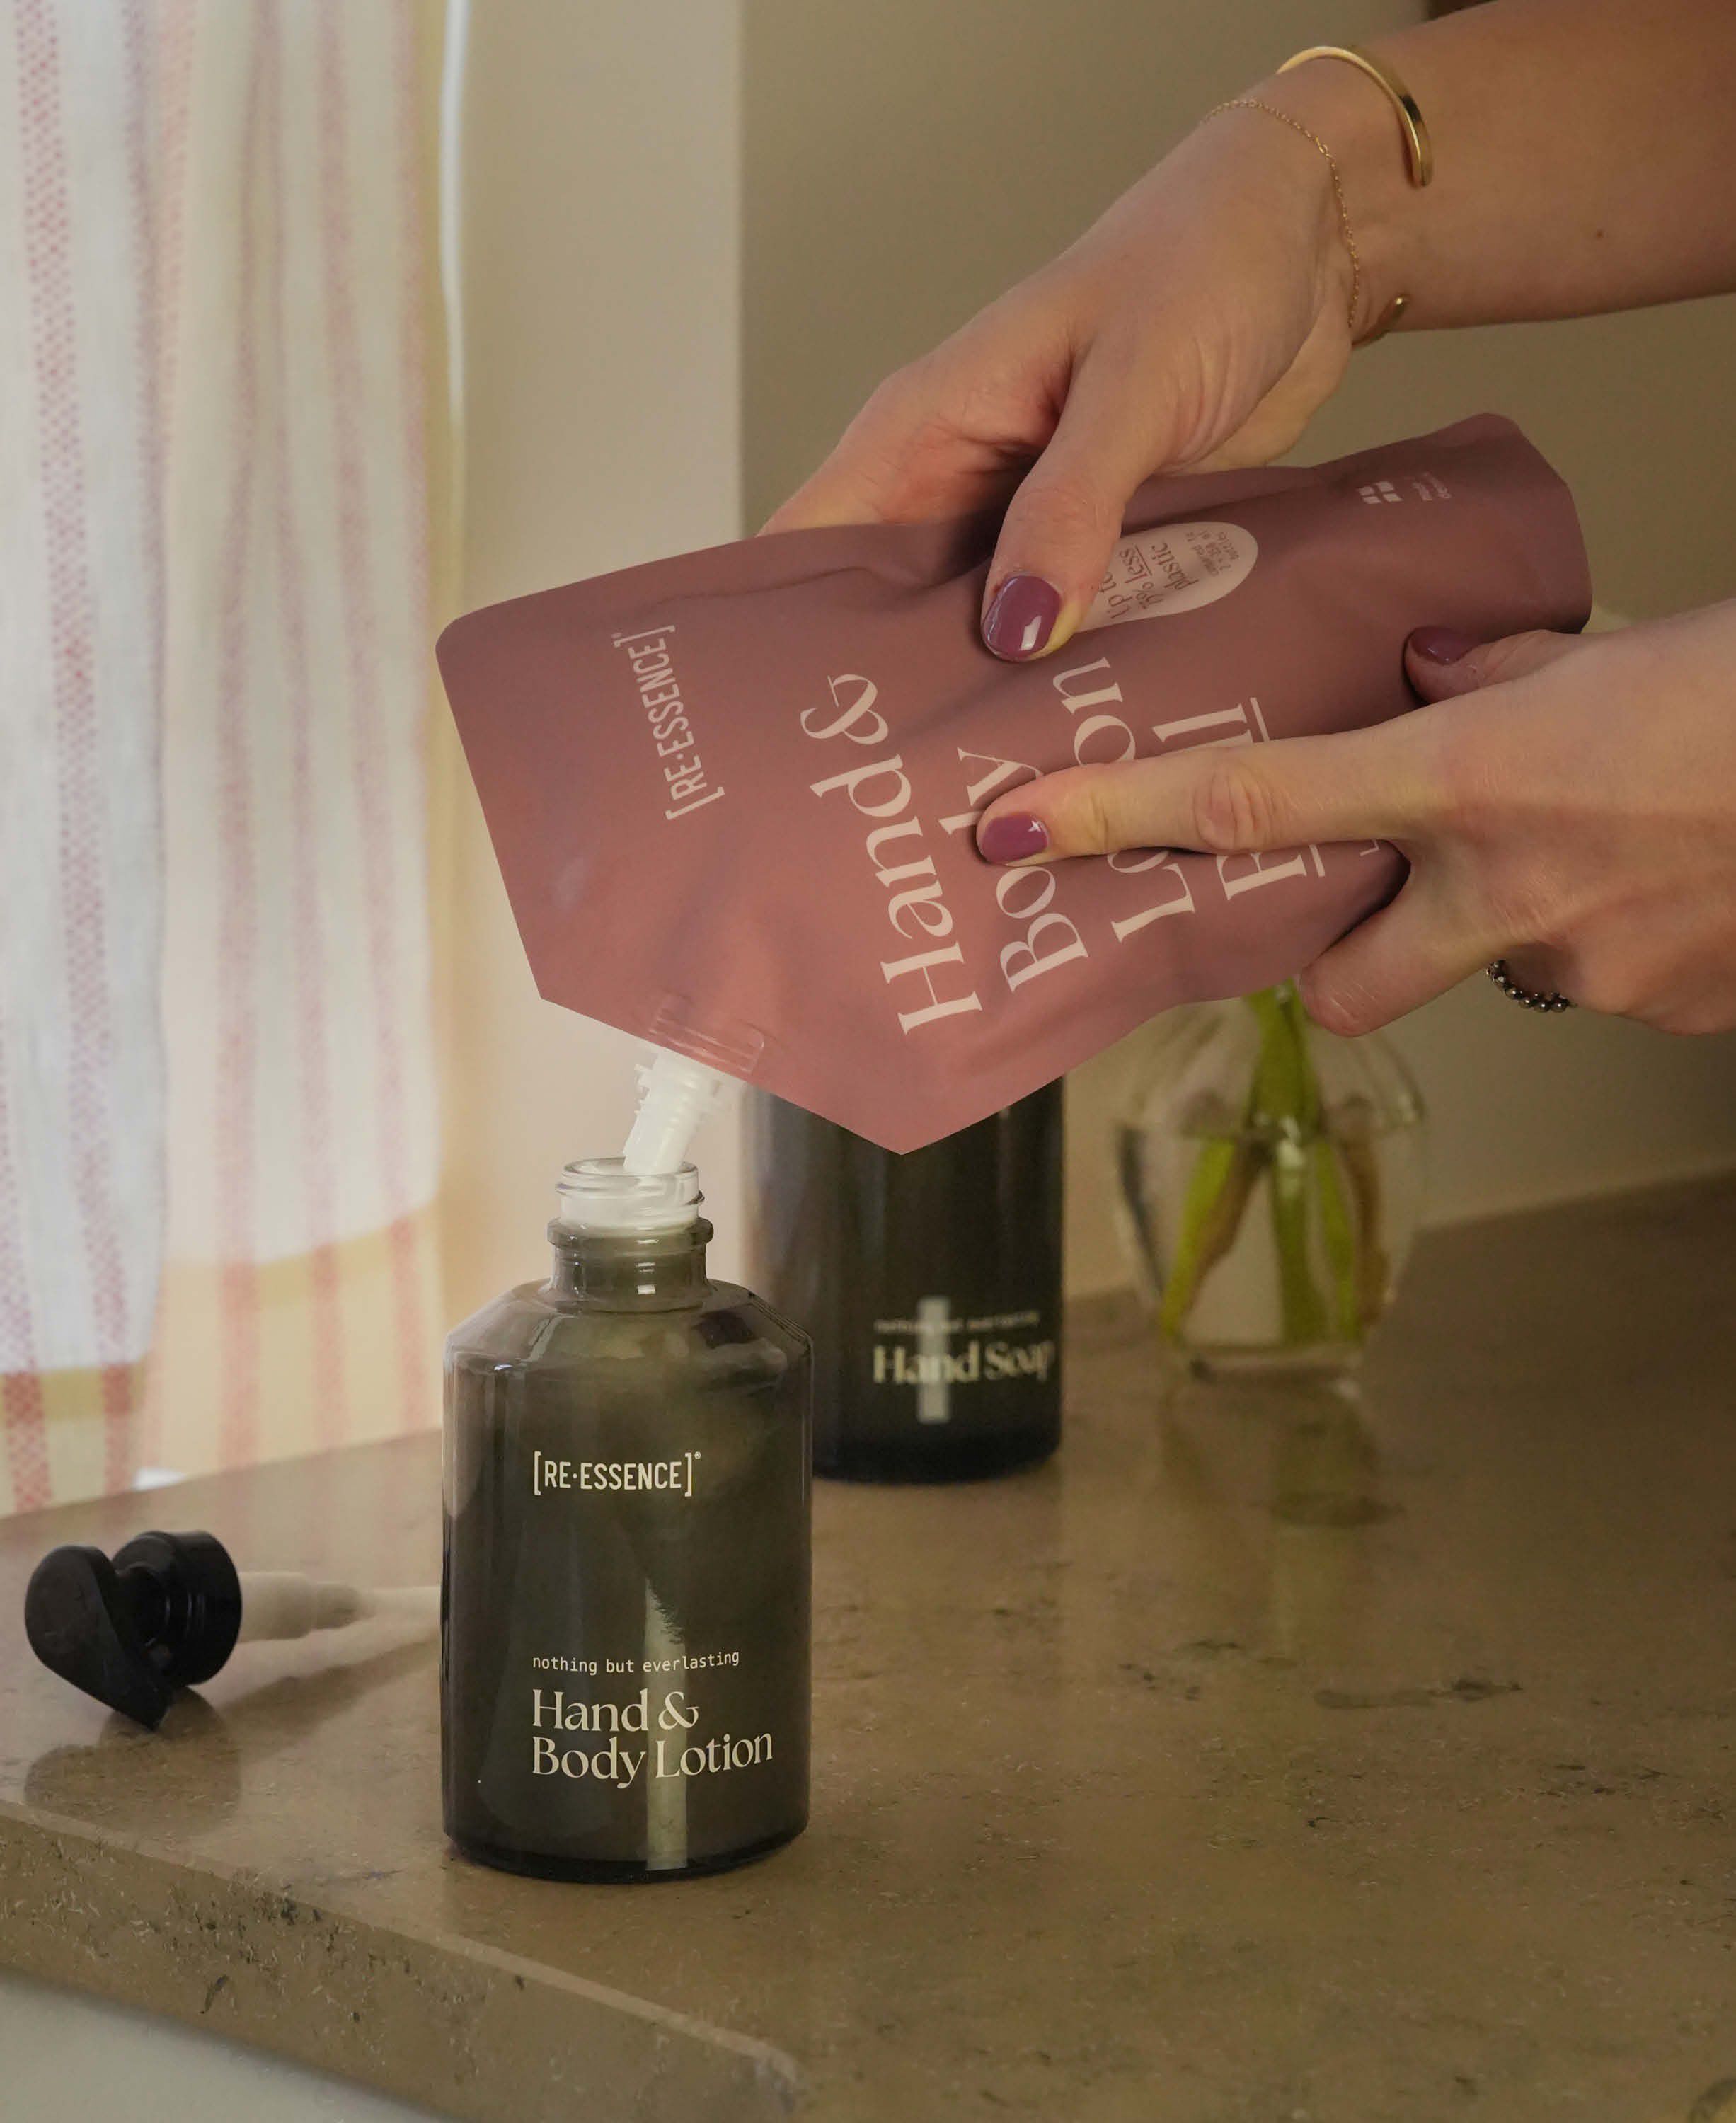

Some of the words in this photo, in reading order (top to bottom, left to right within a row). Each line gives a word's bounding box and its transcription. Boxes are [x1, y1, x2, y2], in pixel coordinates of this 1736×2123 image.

[1119, 546, 1151, 584] less
[800, 674, 889, 745] &
[810, 754, 982, 1035] Hand
[939, 747, 1088, 992] Boy
[873, 1341, 980, 1384] Hand
[532, 1655, 597, 1676] nothing
[606, 1658, 634, 1673] but
[643, 1650, 740, 1672] everlasting
[532, 1688, 648, 1732] Hand
[657, 1691, 699, 1730] &
[532, 1736, 645, 1788] Body
[655, 1732, 773, 1778] Lotion
